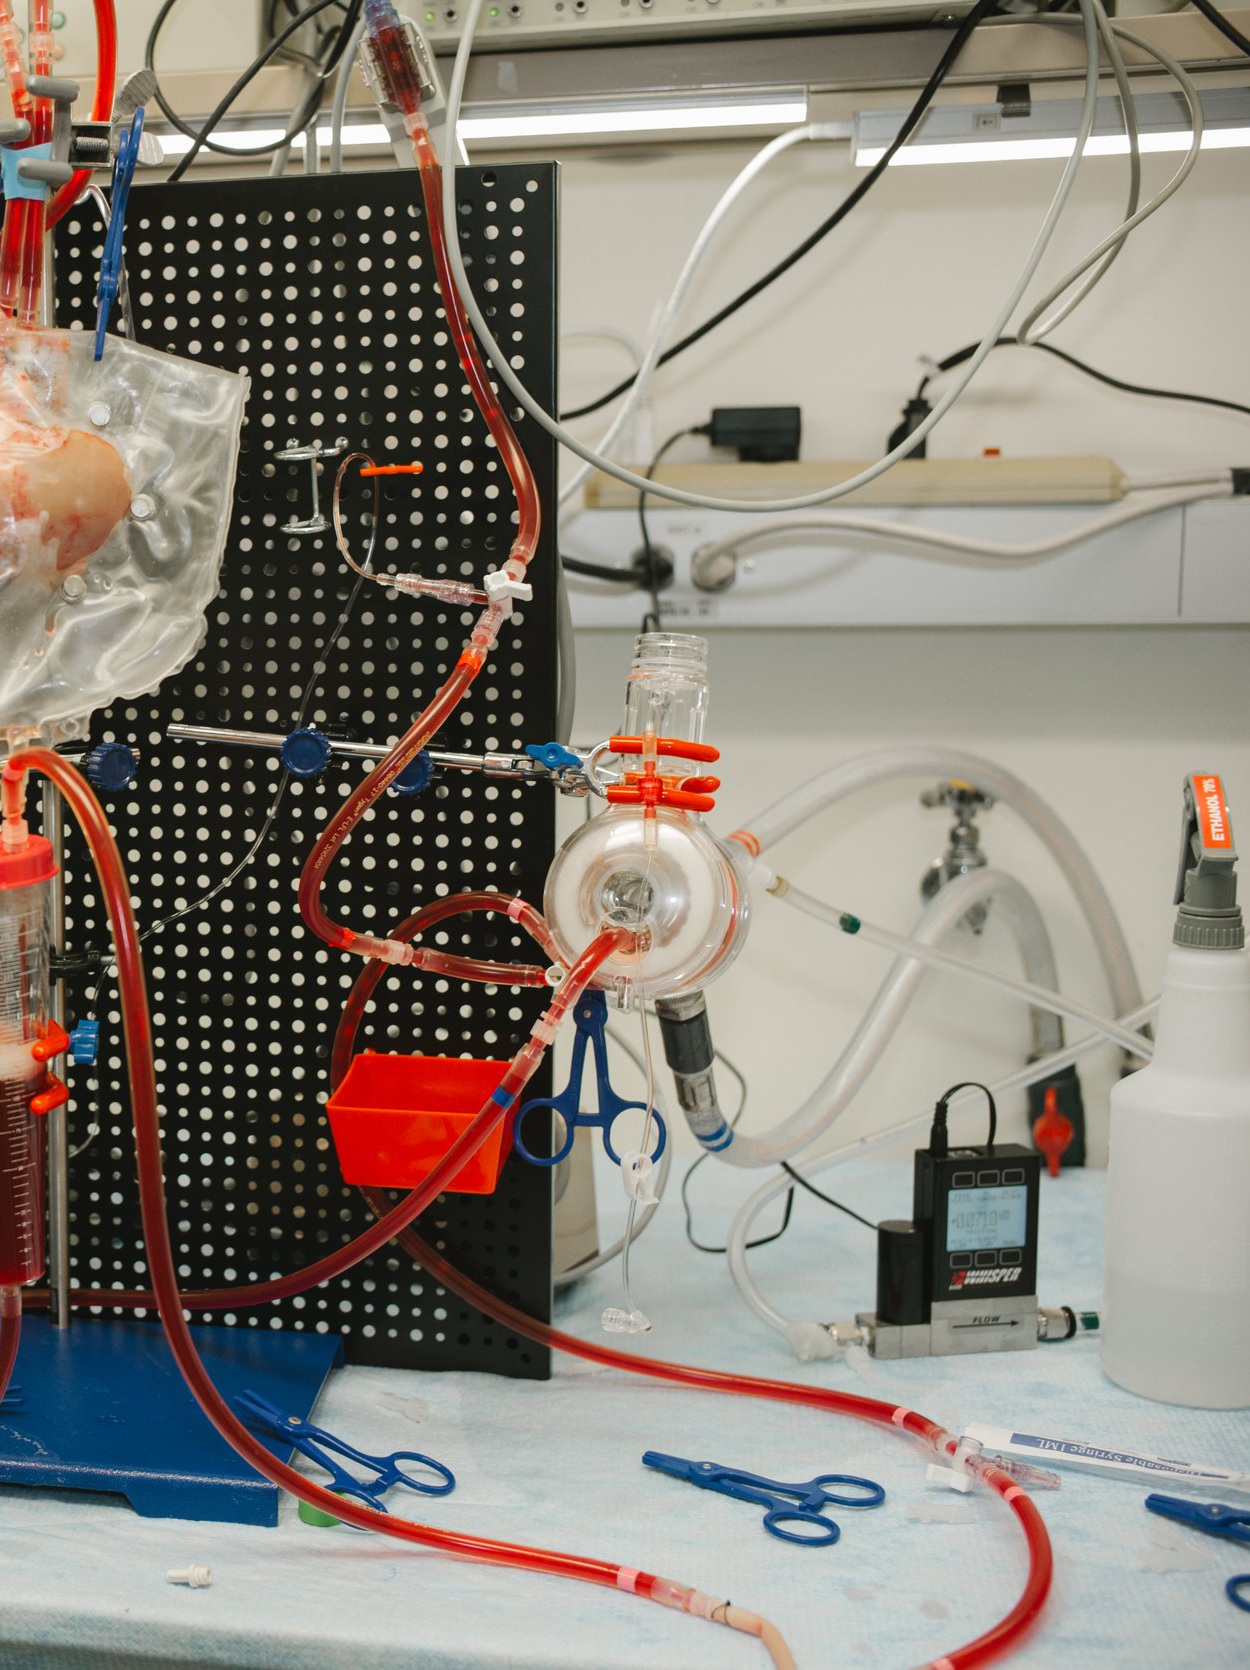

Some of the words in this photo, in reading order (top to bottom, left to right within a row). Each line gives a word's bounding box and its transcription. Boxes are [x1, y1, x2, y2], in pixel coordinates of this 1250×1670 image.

[1202, 778, 1217, 793] 70%
[1206, 794, 1225, 841] ETHANOL
[964, 1267, 1023, 1285] WHISPER
[973, 1315, 1001, 1324] FLOW
[1070, 1444, 1123, 1463] Syringe
